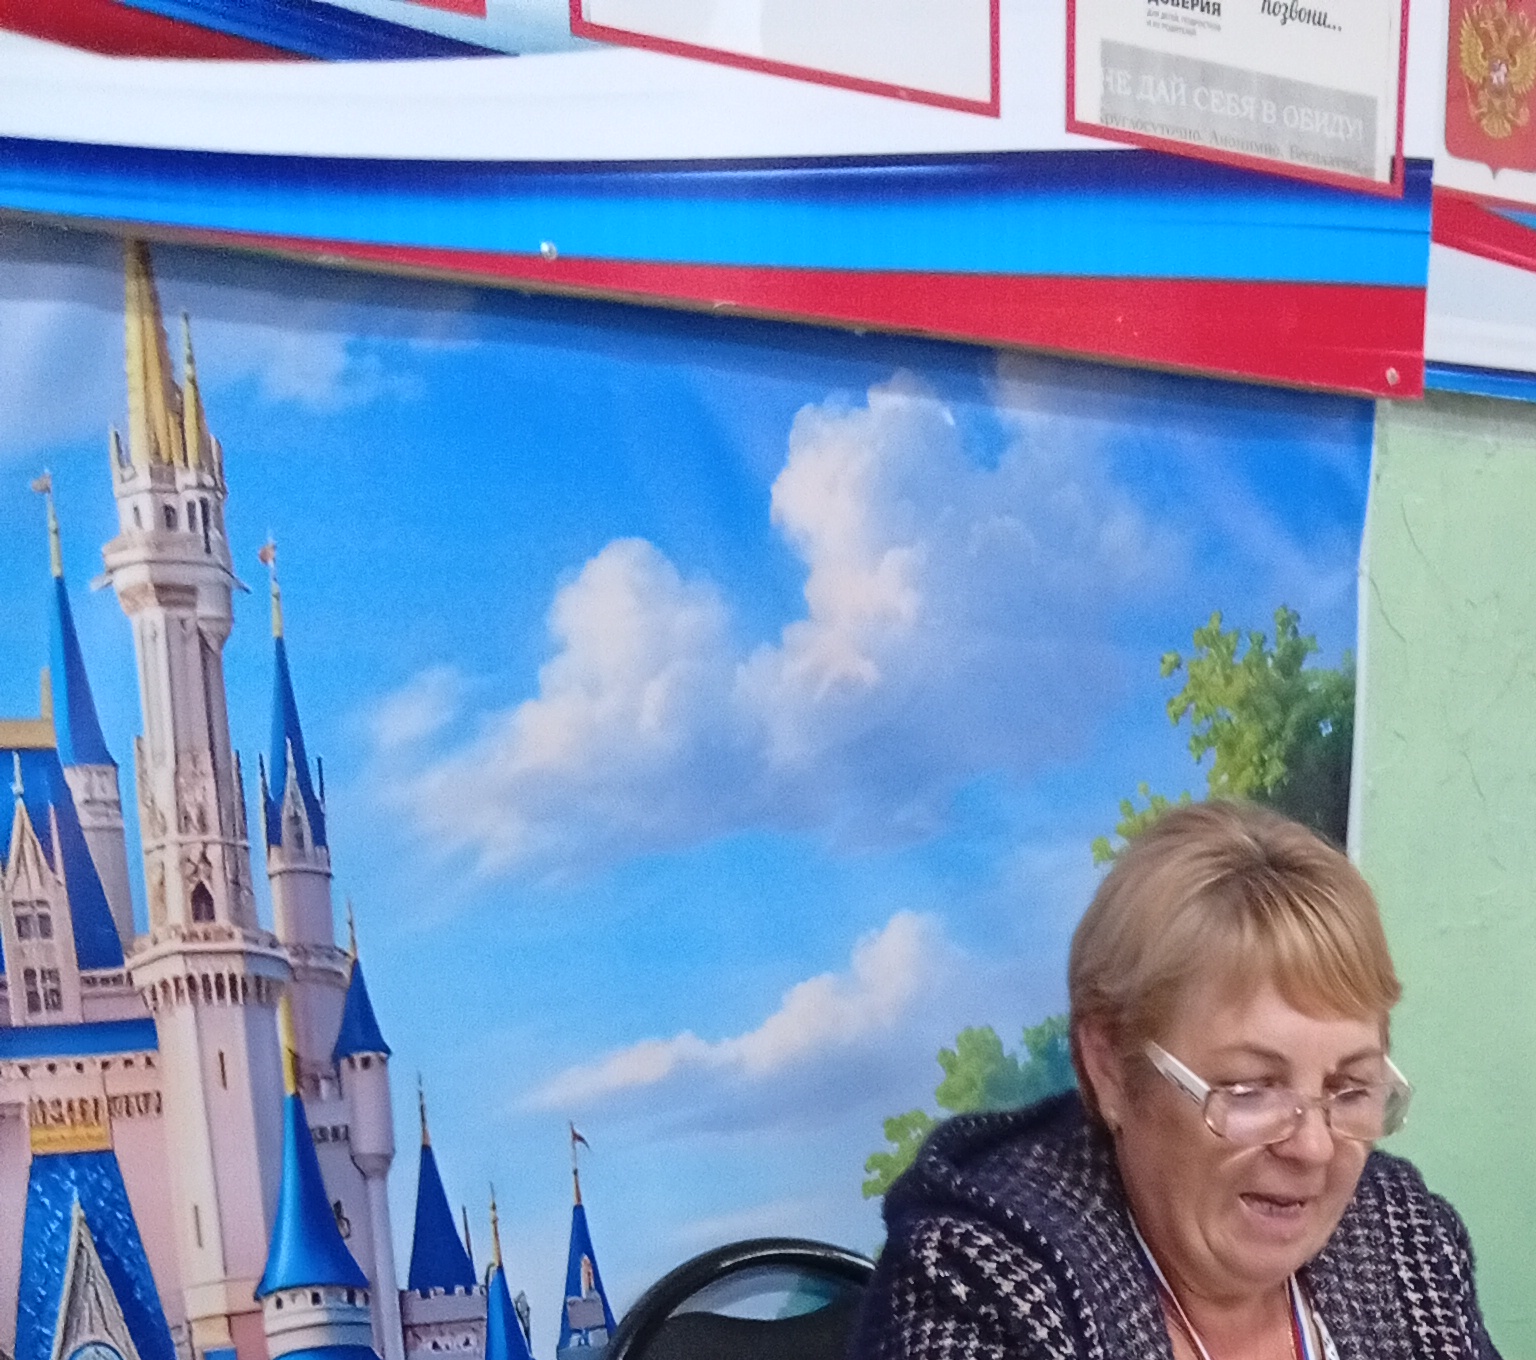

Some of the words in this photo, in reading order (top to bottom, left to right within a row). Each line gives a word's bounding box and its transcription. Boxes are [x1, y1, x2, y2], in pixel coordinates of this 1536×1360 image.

[1102, 68, 1131, 96] НЕ
[1136, 75, 1187, 107] ДАЙ
[1194, 86, 1257, 121] СЕБЯ
[1262, 100, 1276, 123] В
[1283, 105, 1364, 141] ОБИДУ!
